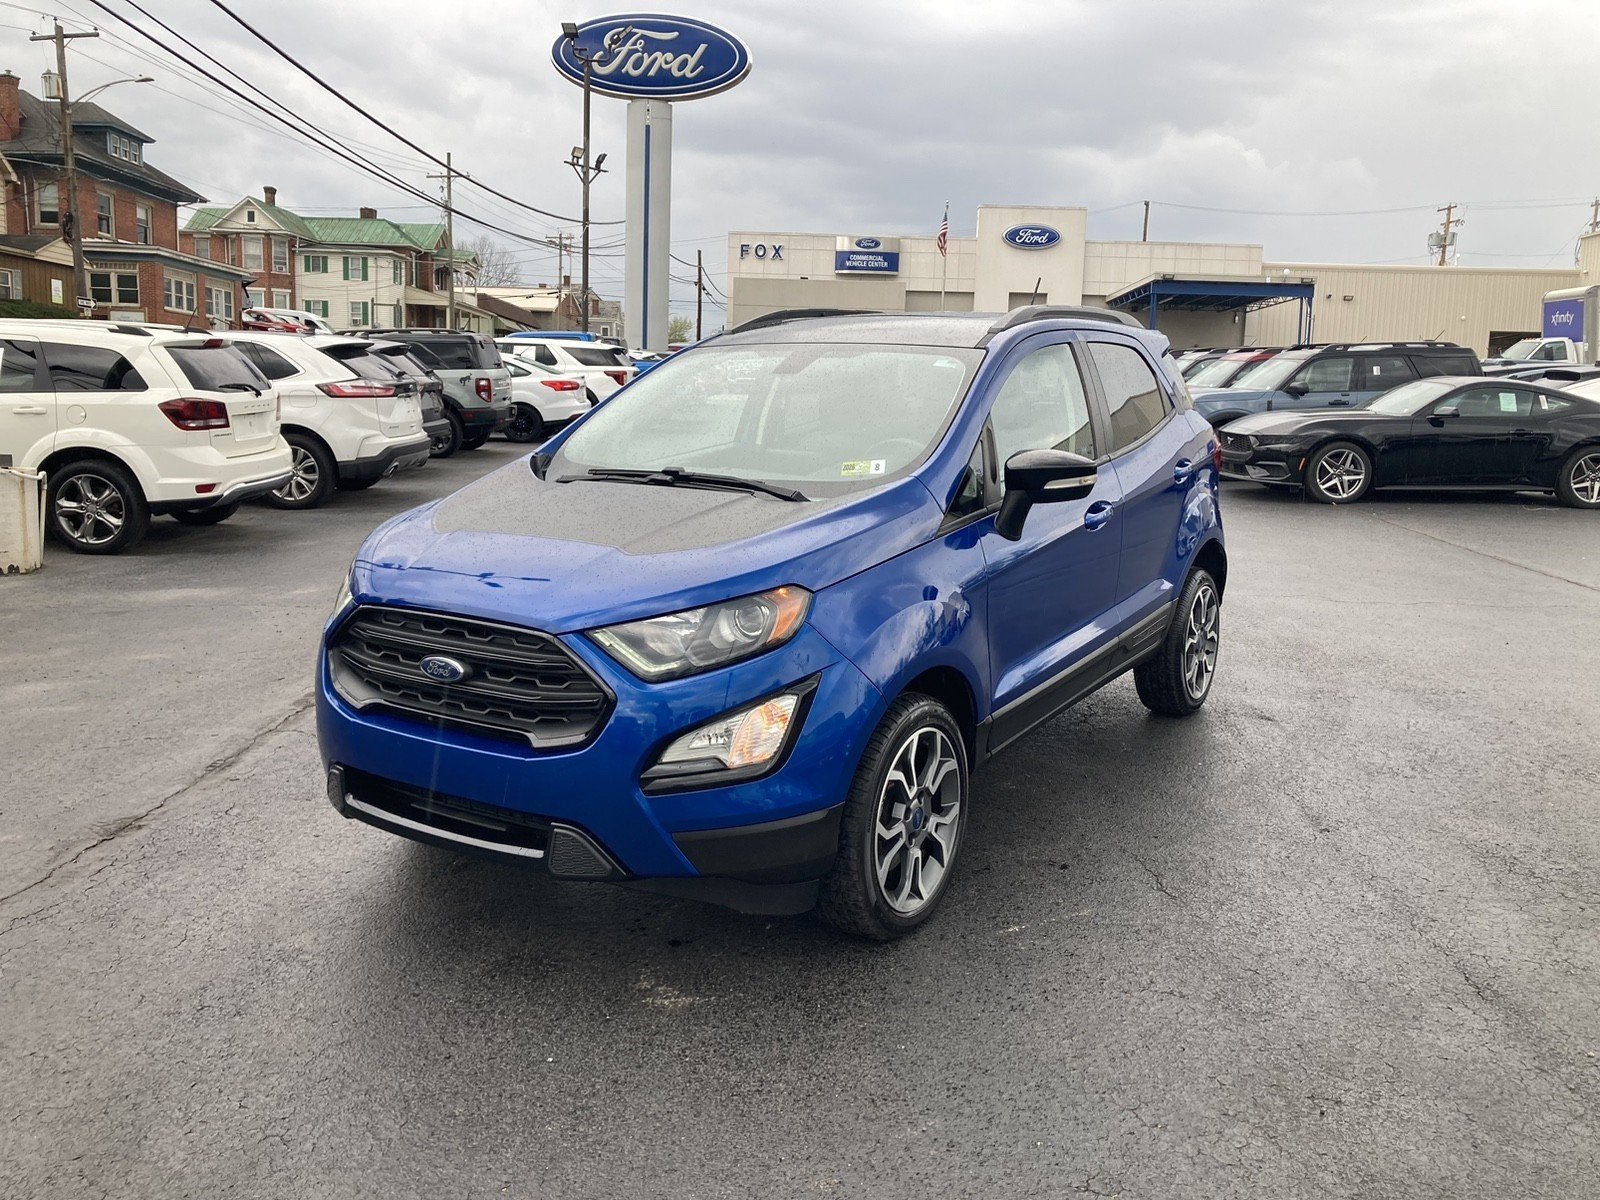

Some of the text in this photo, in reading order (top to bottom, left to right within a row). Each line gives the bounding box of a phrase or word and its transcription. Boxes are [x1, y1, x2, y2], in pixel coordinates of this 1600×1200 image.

[592, 26, 708, 79] Ford
[860, 239, 876, 247] Ford
[1015, 228, 1049, 243] Ford
[740, 244, 783, 260] FOX
[1551, 311, 1574, 326] xfinity
[874, 463, 881, 471] 8
[426, 660, 452, 677] Ford
